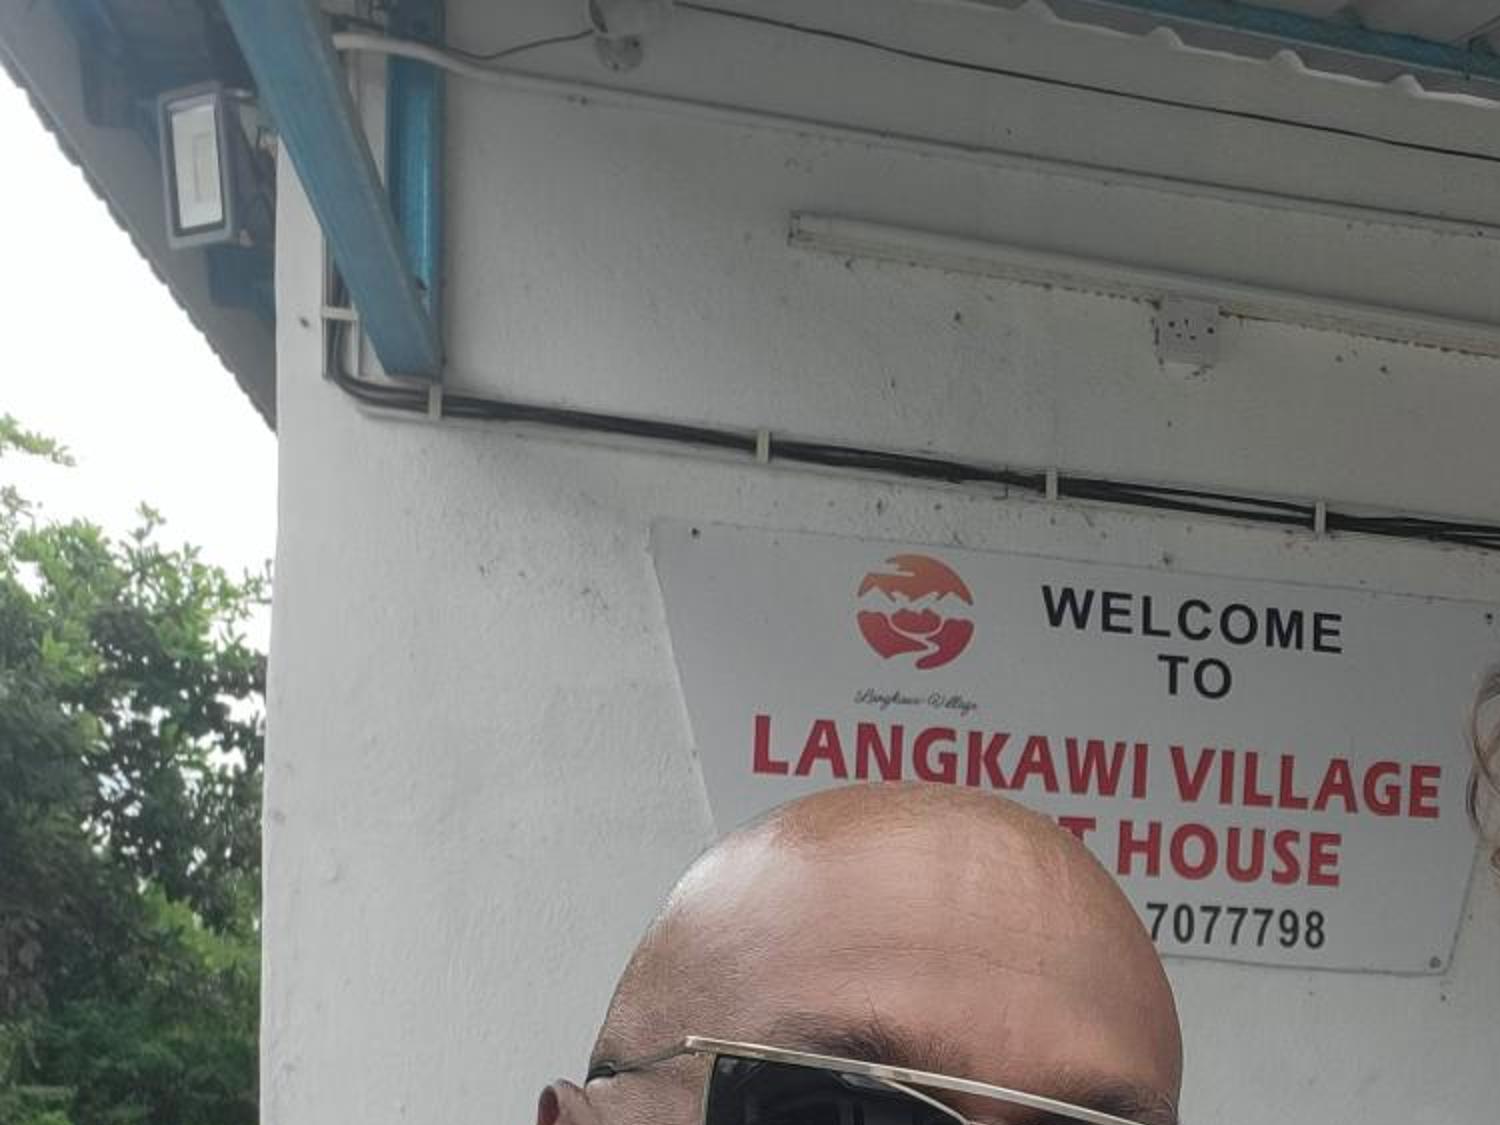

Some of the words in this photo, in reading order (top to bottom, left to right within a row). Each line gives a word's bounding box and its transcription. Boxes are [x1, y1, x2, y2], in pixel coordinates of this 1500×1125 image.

[1040, 584, 1344, 654] WELCOME
[1156, 653, 1234, 701] TO
[752, 714, 1150, 800] LANGKAWI
[1170, 744, 1443, 819] VILLAGE
[1116, 819, 1343, 887] HOUSE
[1146, 902, 1326, 950] 7077798
